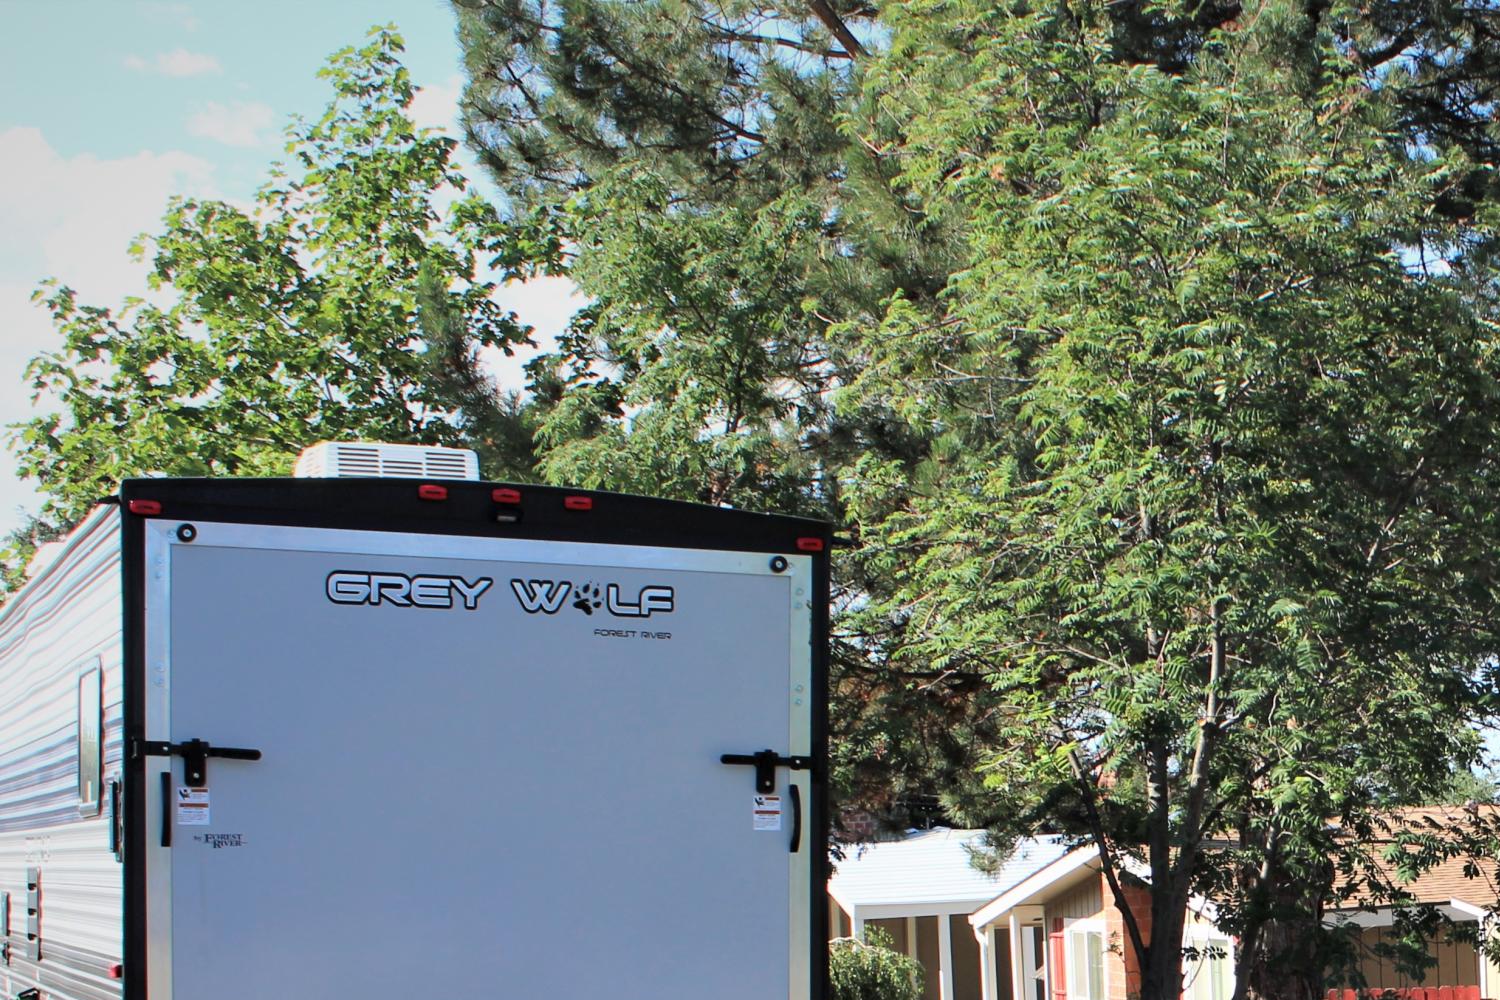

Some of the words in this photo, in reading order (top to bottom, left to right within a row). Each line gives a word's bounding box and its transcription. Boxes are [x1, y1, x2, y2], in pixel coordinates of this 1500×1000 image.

[326, 570, 493, 610] GREY
[593, 628, 637, 638] FOREST
[640, 631, 672, 640] RIVER
